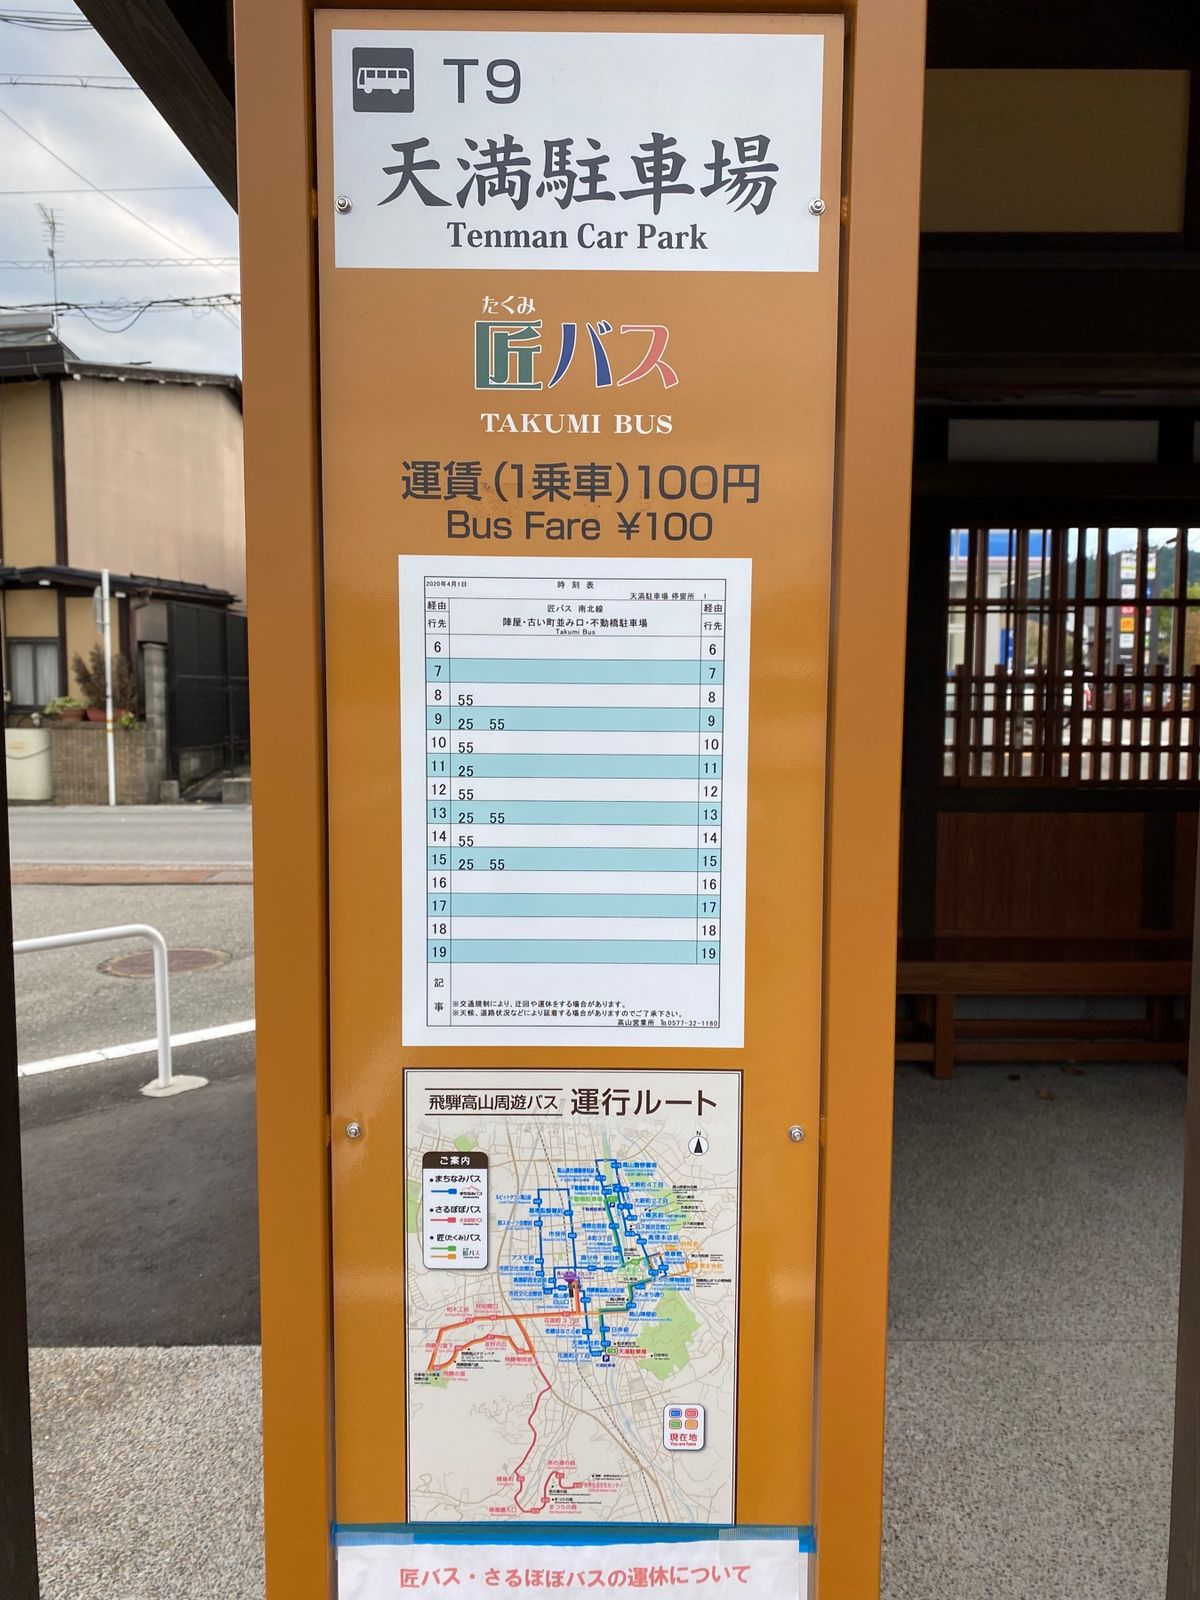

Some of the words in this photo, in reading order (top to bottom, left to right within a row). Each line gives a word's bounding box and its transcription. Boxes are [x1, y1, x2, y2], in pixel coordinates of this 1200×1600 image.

[443, 59, 521, 104] T9
[377, 132, 779, 215] 天満駐車場
[447, 222, 568, 248] Tenman
[578, 223, 628, 248] Car
[637, 224, 708, 249] Park
[483, 296, 535, 314] たくみ
[475, 319, 679, 390] 匠バス
[481, 414, 600, 433] TAKUMI
[615, 415, 672, 434] BUS
[448, 510, 512, 539] Bus
[526, 511, 600, 540] Fare
[617, 512, 712, 541] ¥100
[630, 592, 669, 601] 天満駐車場
[671, 592, 695, 600] 停留所
[427, 601, 447, 611] 経由
[547, 604, 573, 613] 匠バス
[578, 604, 604, 613] 南北線
[703, 603, 723, 613] 経由
[427, 618, 447, 628] 行先
[703, 621, 723, 631] 行先
[555, 628, 580, 636] Takumi
[434, 641, 441, 652] 6
[710, 644, 716, 655] 6
[435, 666, 441, 676] 7
[709, 668, 715, 679] 7
[435, 689, 441, 700] 8
[458, 695, 473, 706] 55
[709, 692, 715, 703] 8
[435, 713, 441, 724] 9
[459, 719, 473, 730] 25
[490, 719, 504, 730] 55
[708, 715, 715, 726] 9
[432, 737, 446, 748] 10
[459, 742, 473, 753] 55
[705, 739, 719, 750] 10
[432, 761, 444, 772] 11
[459, 766, 473, 777] 25
[704, 763, 717, 773] 11
[432, 784, 446, 796] 12
[459, 789, 473, 800] 55
[704, 786, 718, 797] 12
[432, 807, 446, 818] 13
[459, 813, 473, 824] 25
[490, 813, 504, 824] 55
[703, 809, 718, 820] 13
[432, 831, 446, 842] 14
[459, 836, 473, 847] 55
[703, 833, 718, 843] 14
[432, 854, 446, 866] 15
[458, 859, 473, 870] 25
[489, 858, 504, 870] 55
[703, 856, 717, 866] 15
[432, 877, 446, 888] 16
[702, 879, 717, 889] 16
[432, 900, 446, 912] 17
[702, 902, 717, 912] 17
[432, 923, 446, 934] 18
[702, 925, 717, 936] 18
[432, 947, 446, 958] 19
[702, 948, 716, 959] 19
[570, 1088, 718, 1117] 運行ルート
[440, 1156, 471, 1166] ご案内
[435, 1174, 482, 1183] まちなみバス
[670, 1433, 698, 1442] 現在地
